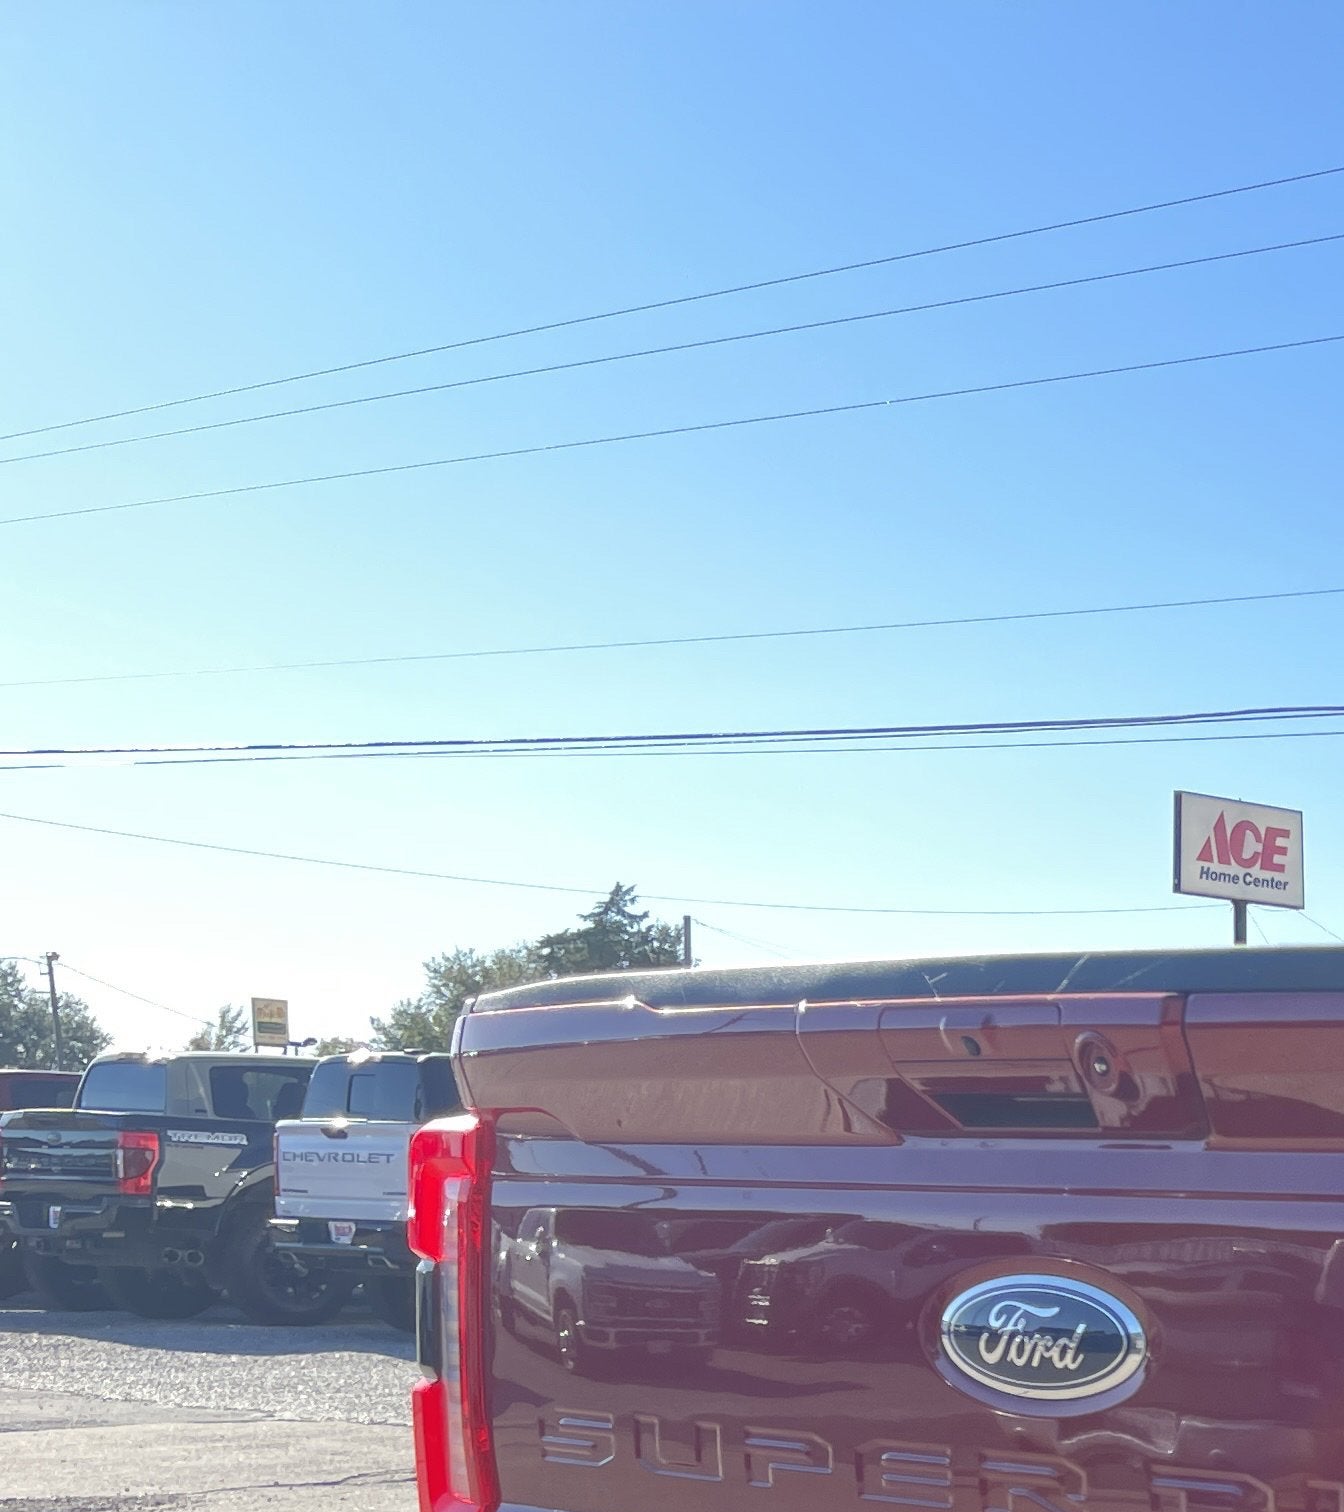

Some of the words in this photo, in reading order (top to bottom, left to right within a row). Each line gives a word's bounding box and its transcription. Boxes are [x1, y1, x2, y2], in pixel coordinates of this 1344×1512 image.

[1196, 810, 1290, 873] ACE
[1200, 866, 1240, 884] Home
[1242, 872, 1289, 890] Center
[167, 1130, 248, 1145] TREMOR
[282, 1151, 394, 1163] CHEVROLET
[978, 1300, 1087, 1370] Ford
